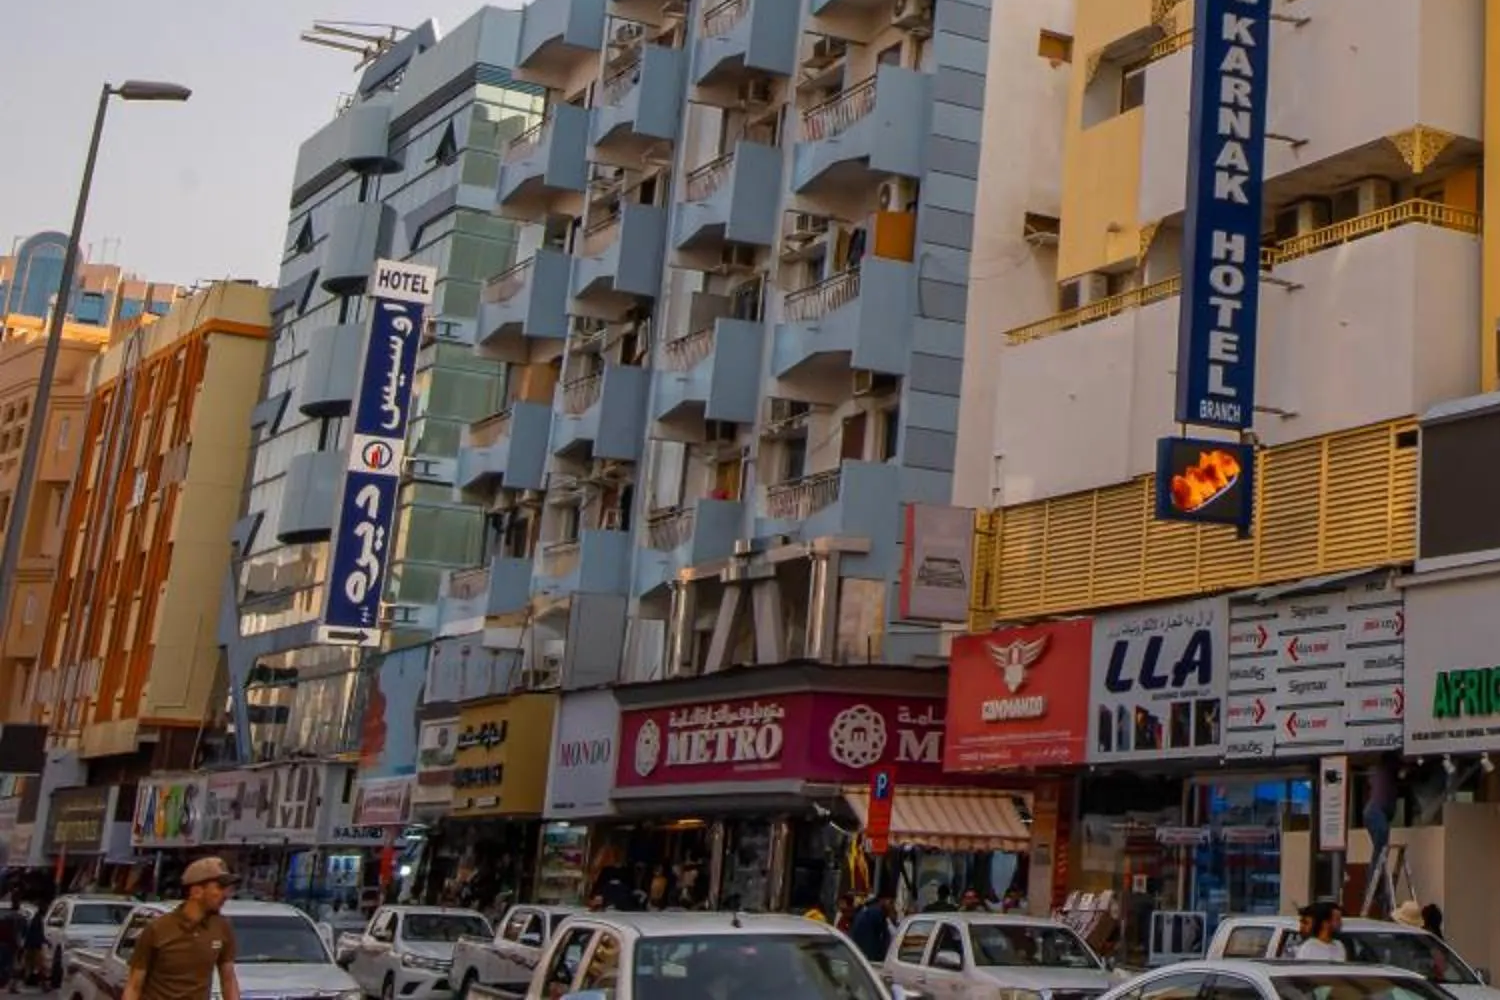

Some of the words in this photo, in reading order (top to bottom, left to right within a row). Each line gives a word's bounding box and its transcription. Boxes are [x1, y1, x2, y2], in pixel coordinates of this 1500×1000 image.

[1213, 12, 1256, 205] KARNAK
[378, 267, 430, 295] HOTEL
[1206, 230, 1246, 398] HOTEL
[1200, 399, 1242, 423] BRANCH
[561, 737, 611, 768] MONDO
[665, 723, 784, 767] METRO
[875, 772, 887, 791] P
